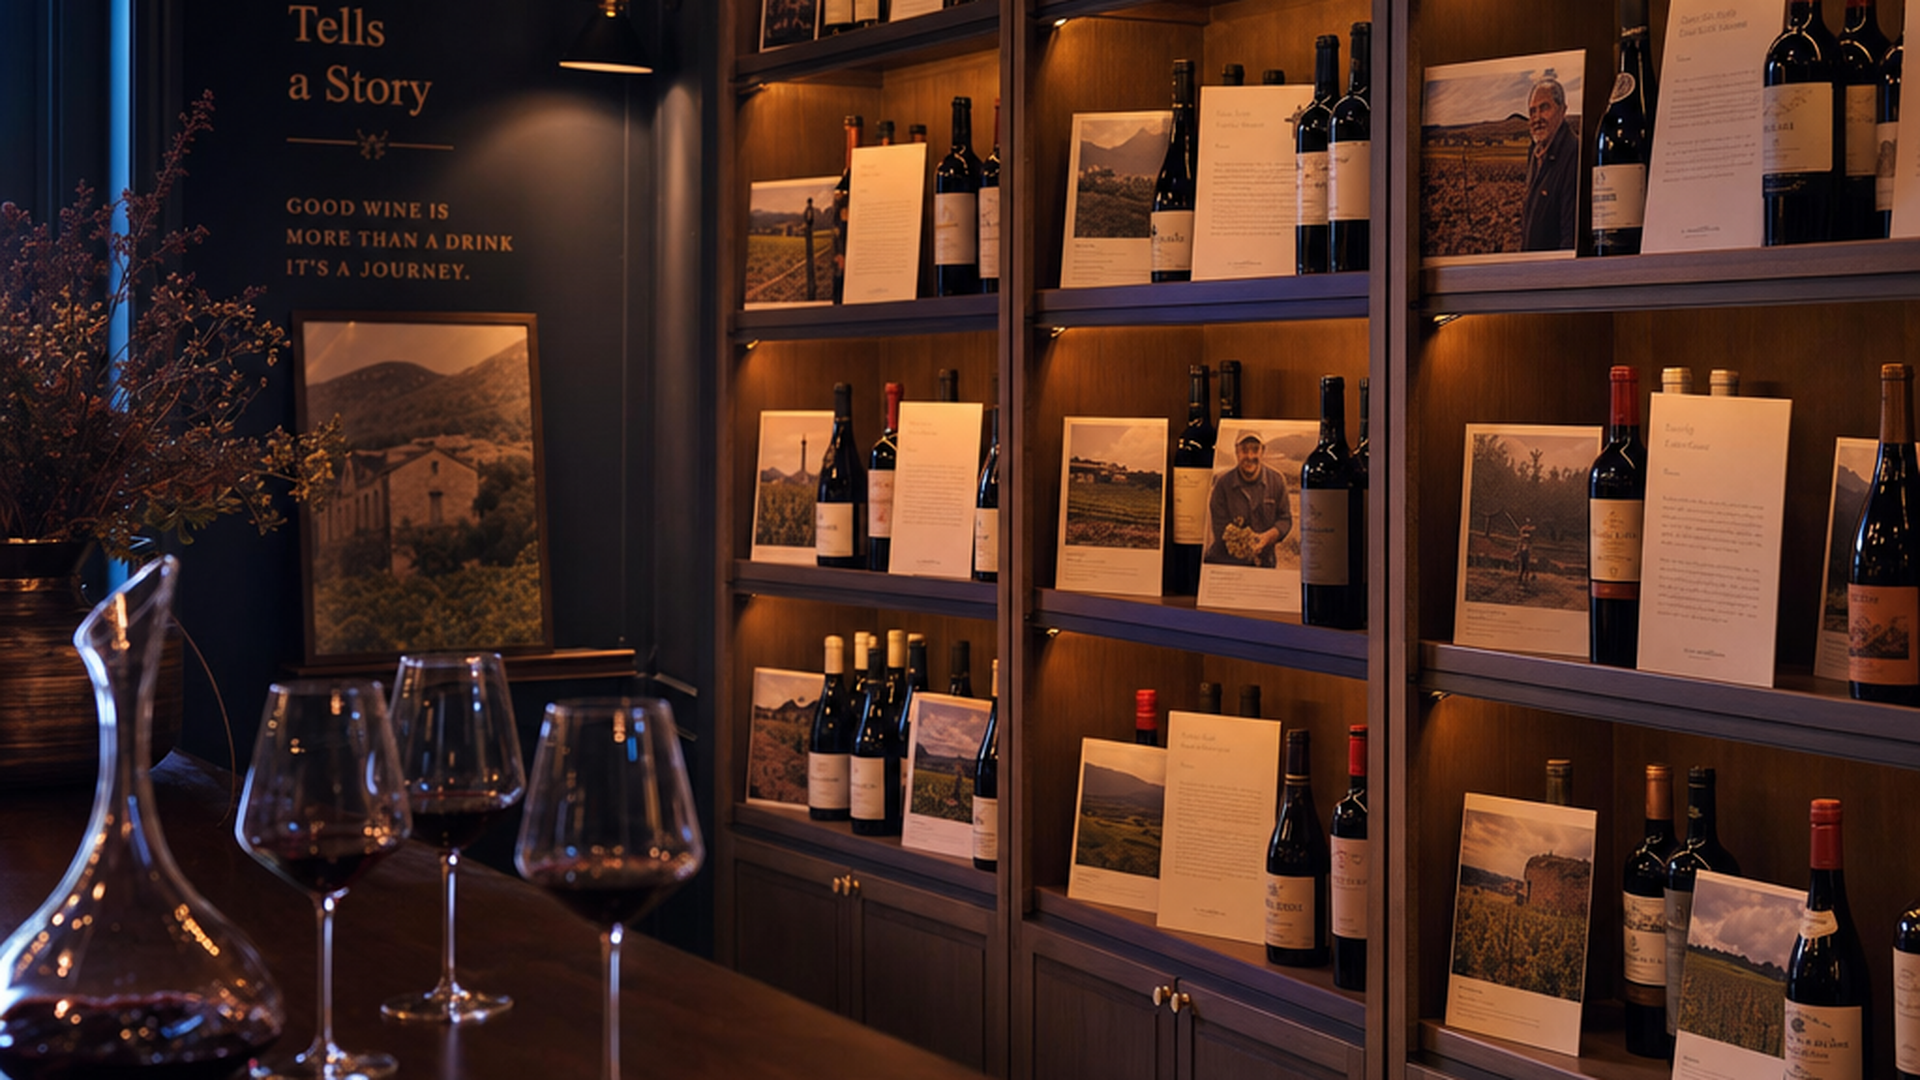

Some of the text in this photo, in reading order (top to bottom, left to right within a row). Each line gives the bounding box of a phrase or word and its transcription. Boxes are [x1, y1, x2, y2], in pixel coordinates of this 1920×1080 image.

[289, 5, 385, 47] Tells
[288, 65, 432, 117] a Story
[286, 198, 449, 220] GOOD WINE IS
[286, 229, 513, 252] MORE THAN A DRINK
[286, 260, 470, 281] IT'S A JOURNEY.
